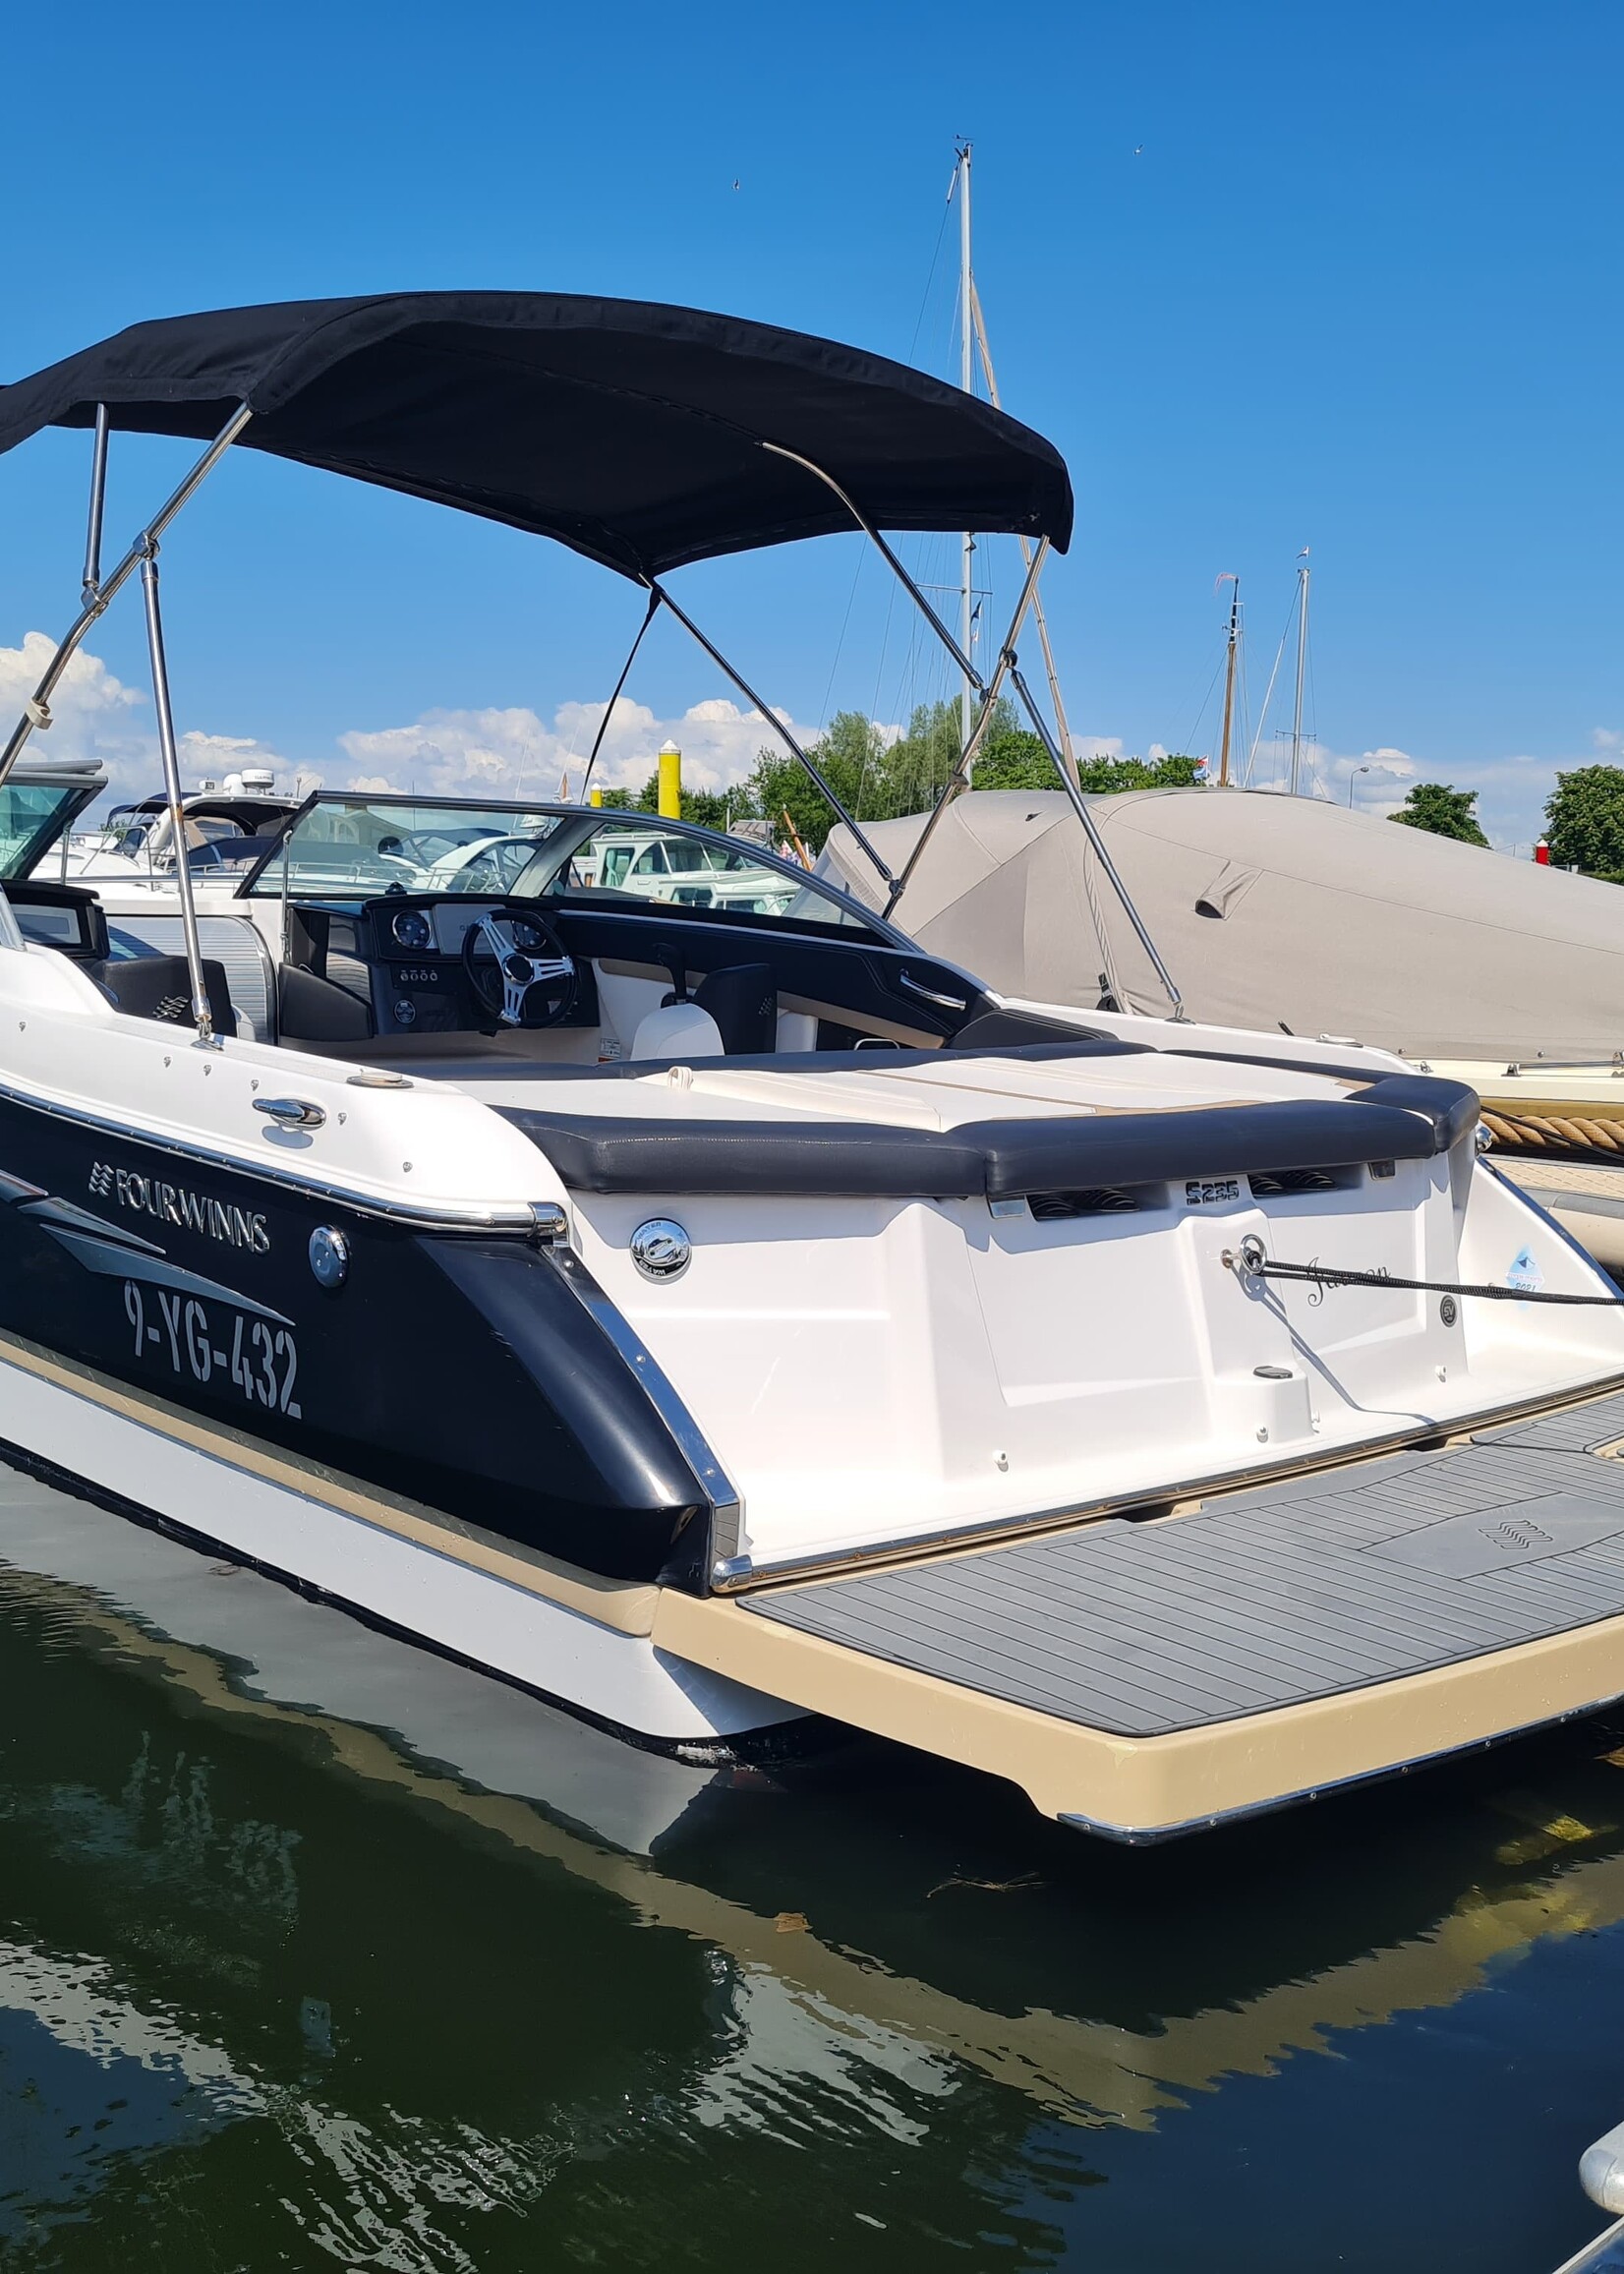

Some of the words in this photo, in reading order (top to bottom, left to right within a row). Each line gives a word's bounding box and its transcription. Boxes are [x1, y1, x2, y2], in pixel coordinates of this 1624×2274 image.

[1186, 1180, 1240, 1206] S235
[1515, 1282, 1537, 1291] 2021
[124, 1279, 302, 1420] 9-YG-432
